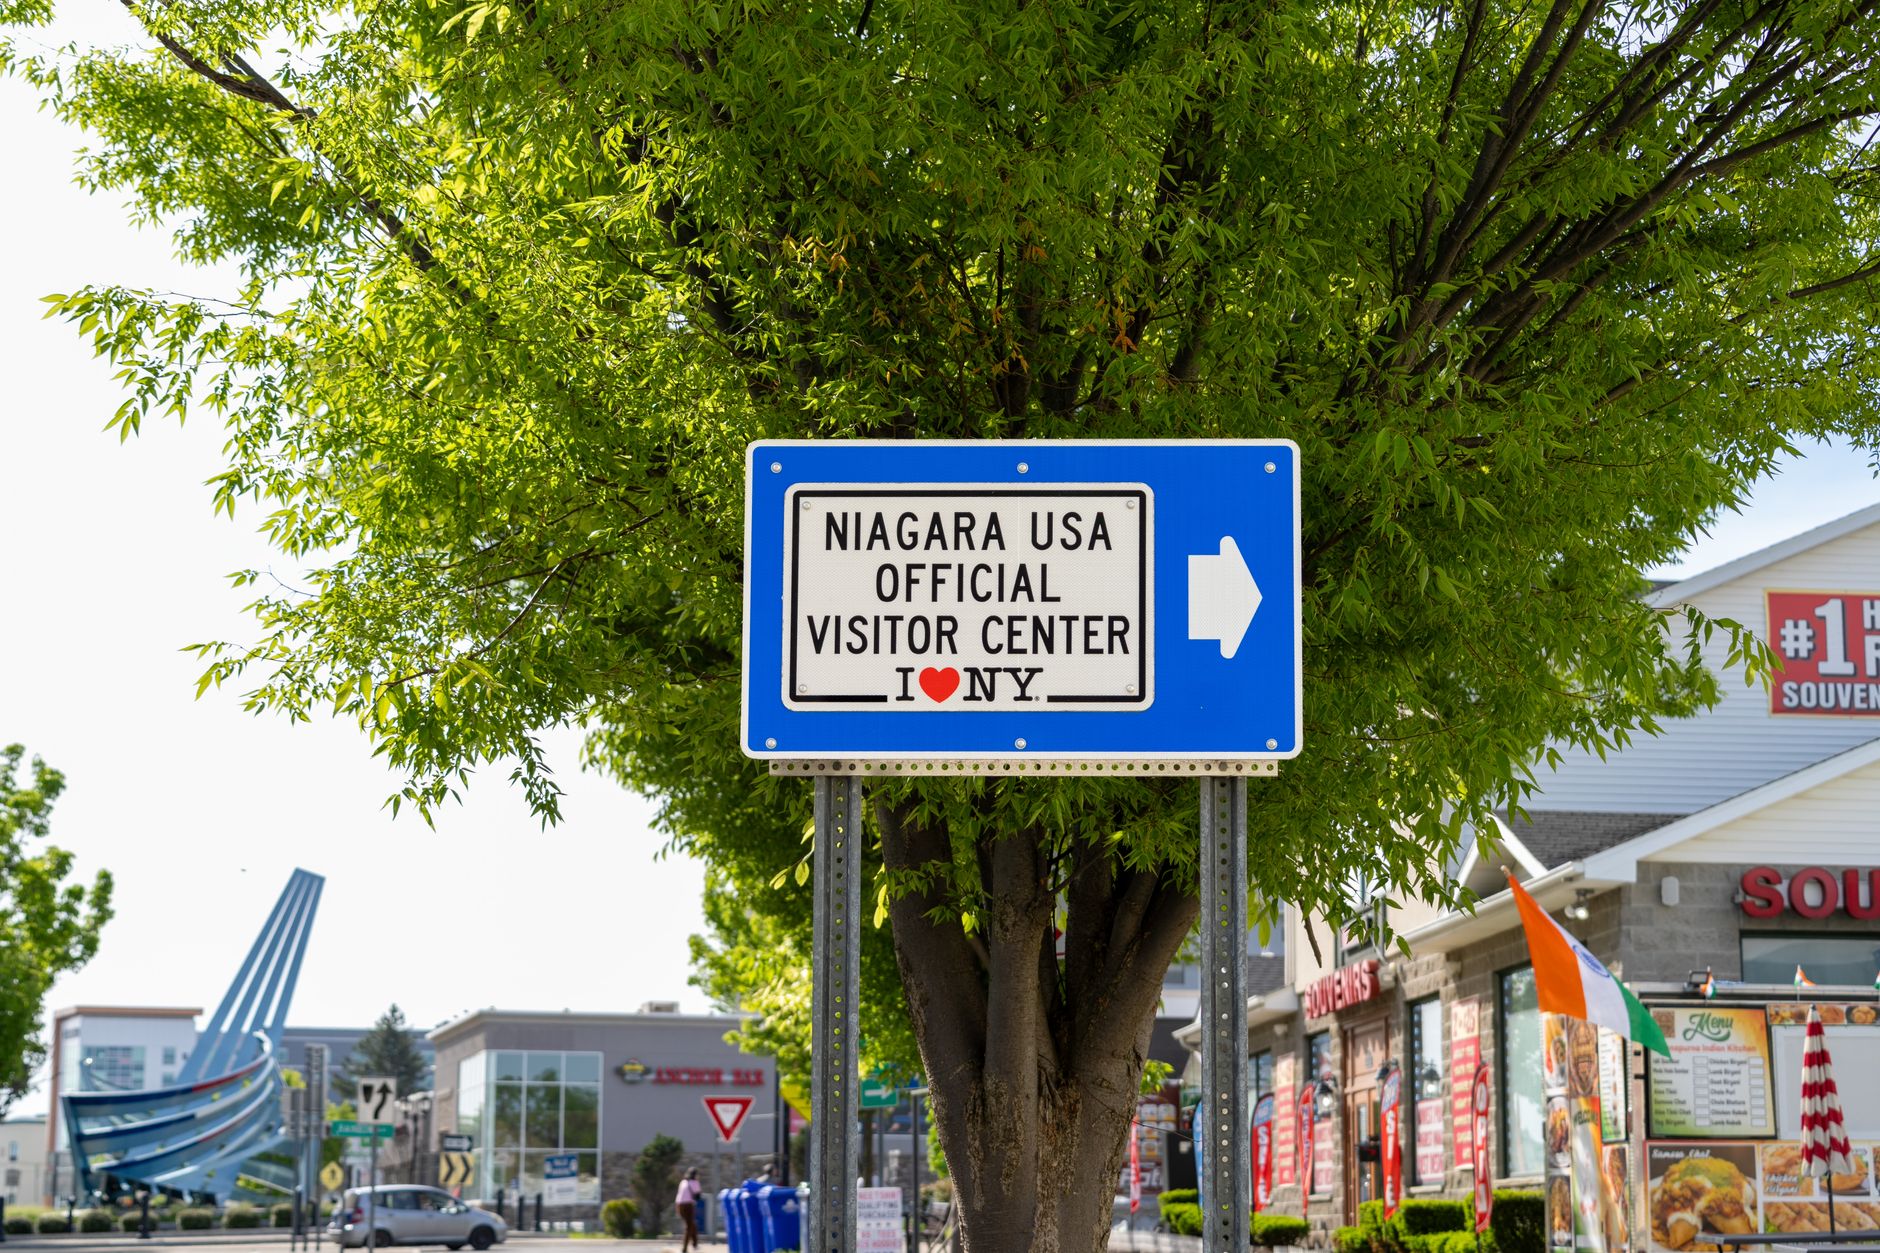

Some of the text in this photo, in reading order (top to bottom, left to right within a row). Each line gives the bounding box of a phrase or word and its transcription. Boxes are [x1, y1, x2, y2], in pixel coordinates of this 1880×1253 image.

[824, 511, 1112, 551] NIAGARA USA
[875, 563, 1061, 602] OFFICIAL
[807, 615, 1131, 655] VISITOR CENTER
[1780, 598, 1855, 676] #1
[896, 667, 915, 701] I
[1741, 867, 1880, 919] SOU
[1683, 1012, 1734, 1042] Menu
[653, 1066, 723, 1086] ANCHOR
[731, 1066, 765, 1086] BAR
